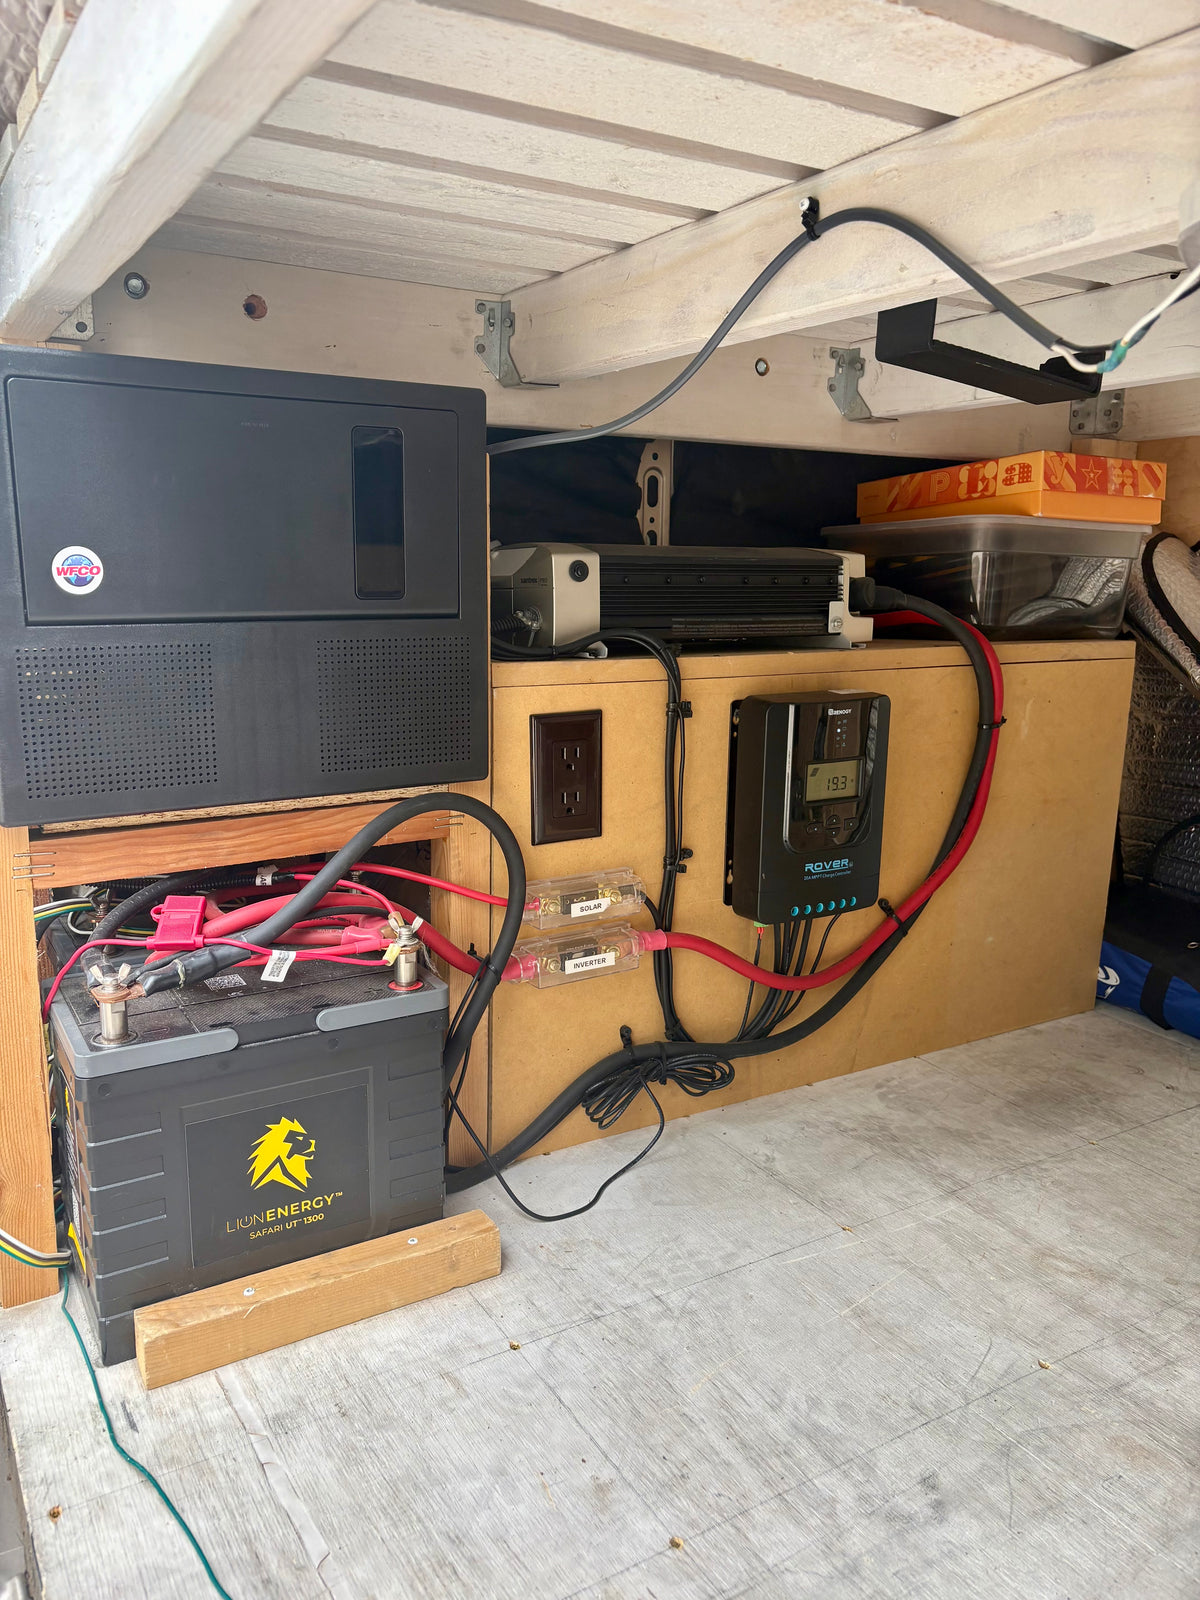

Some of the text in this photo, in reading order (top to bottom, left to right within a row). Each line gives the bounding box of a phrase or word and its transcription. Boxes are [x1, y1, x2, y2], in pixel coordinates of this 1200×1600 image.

[56, 565, 101, 577] WFCO
[827, 776, 848, 791] 19.3
[580, 903, 602, 913] SOLAR
[573, 957, 607, 969] INVERTER
[249, 1224, 283, 1240] SAFARI
[303, 1213, 325, 1225] 1300
